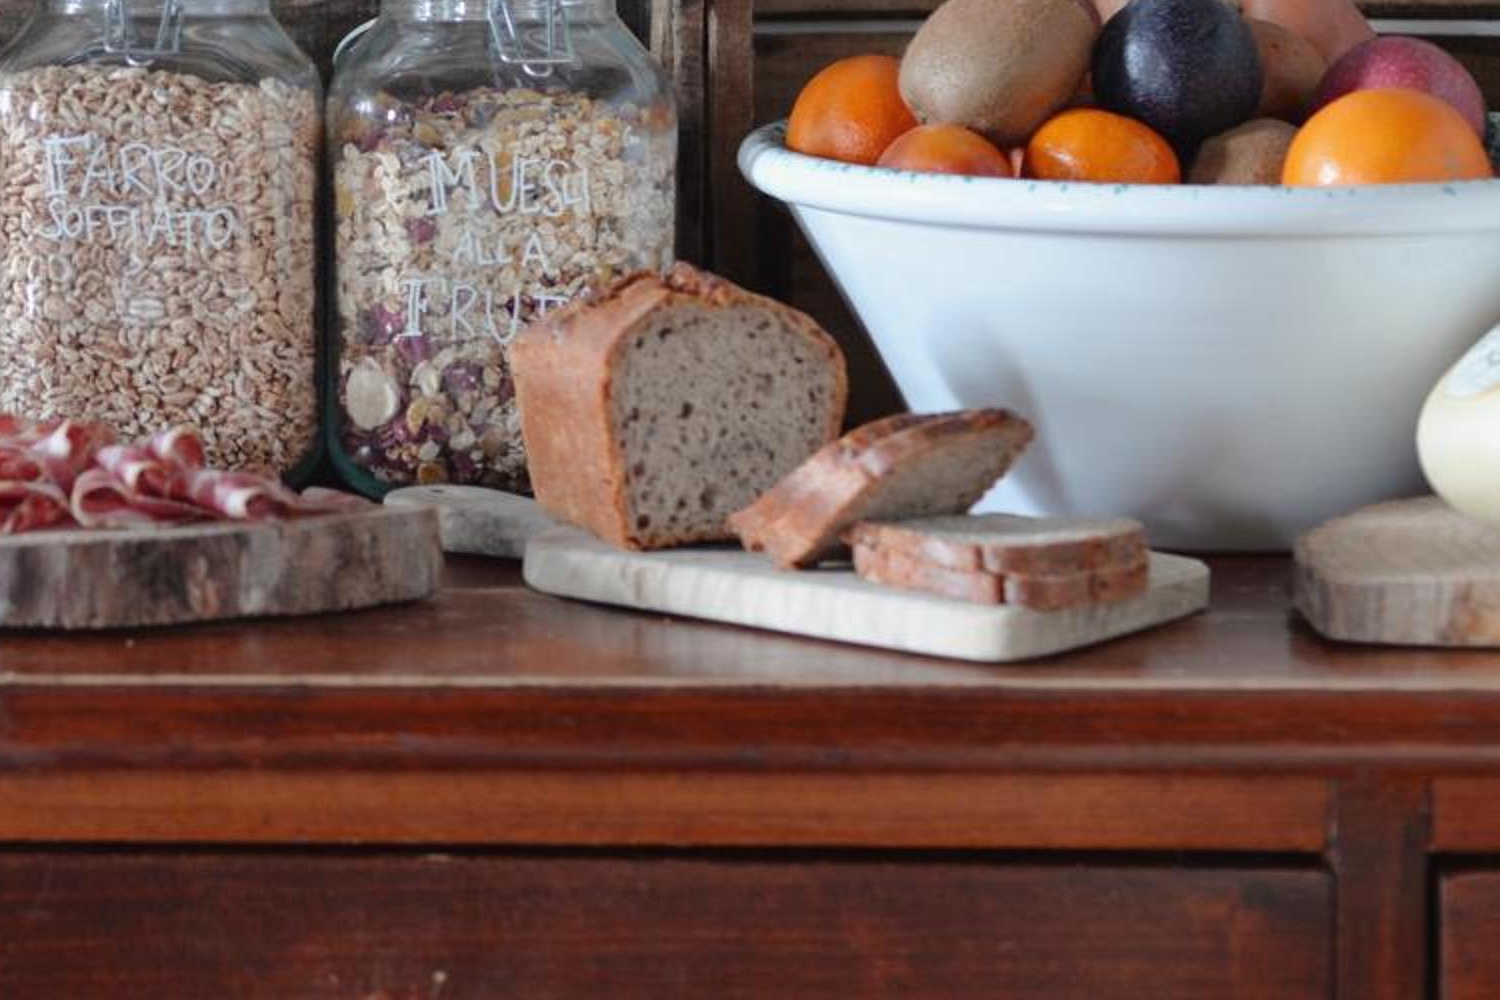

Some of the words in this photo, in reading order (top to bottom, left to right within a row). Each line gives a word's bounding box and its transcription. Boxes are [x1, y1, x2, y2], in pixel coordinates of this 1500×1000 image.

[44, 133, 214, 198] FARRO
[418, 150, 592, 216] MUESLI
[36, 198, 234, 250] SOFFIATO
